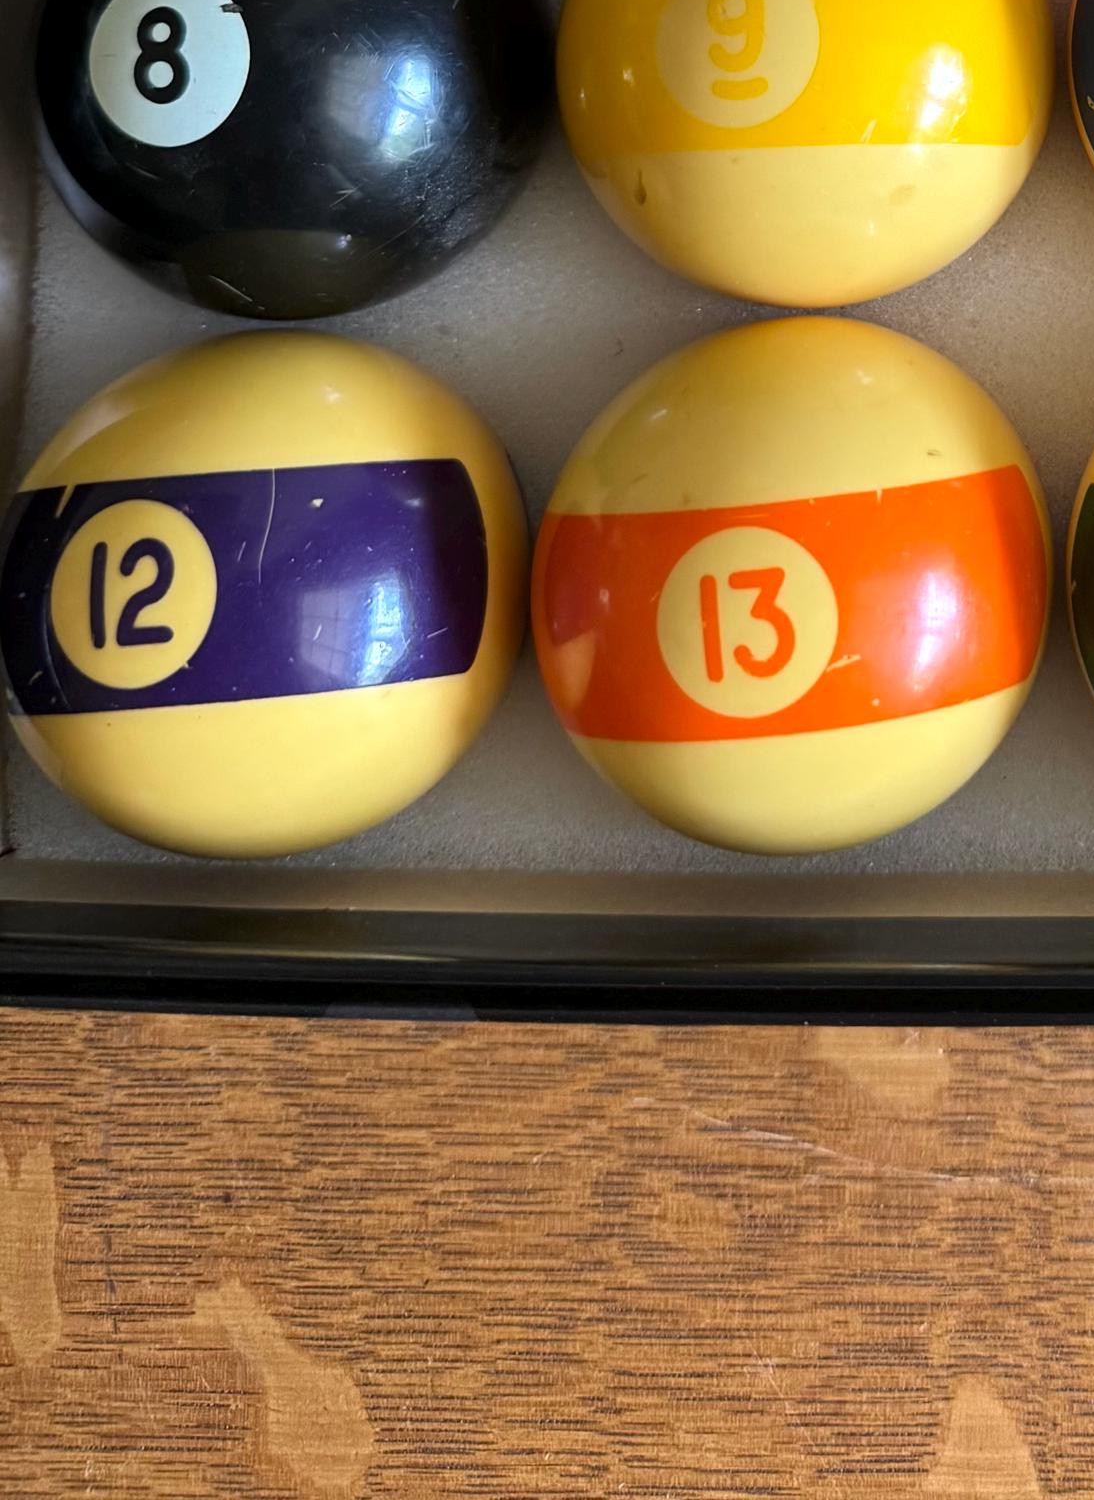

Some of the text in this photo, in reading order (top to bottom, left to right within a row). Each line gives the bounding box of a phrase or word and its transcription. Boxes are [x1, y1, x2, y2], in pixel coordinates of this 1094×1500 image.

[134, 6, 190, 104] 8
[90, 538, 175, 649] 12
[700, 566, 796, 683] 13
